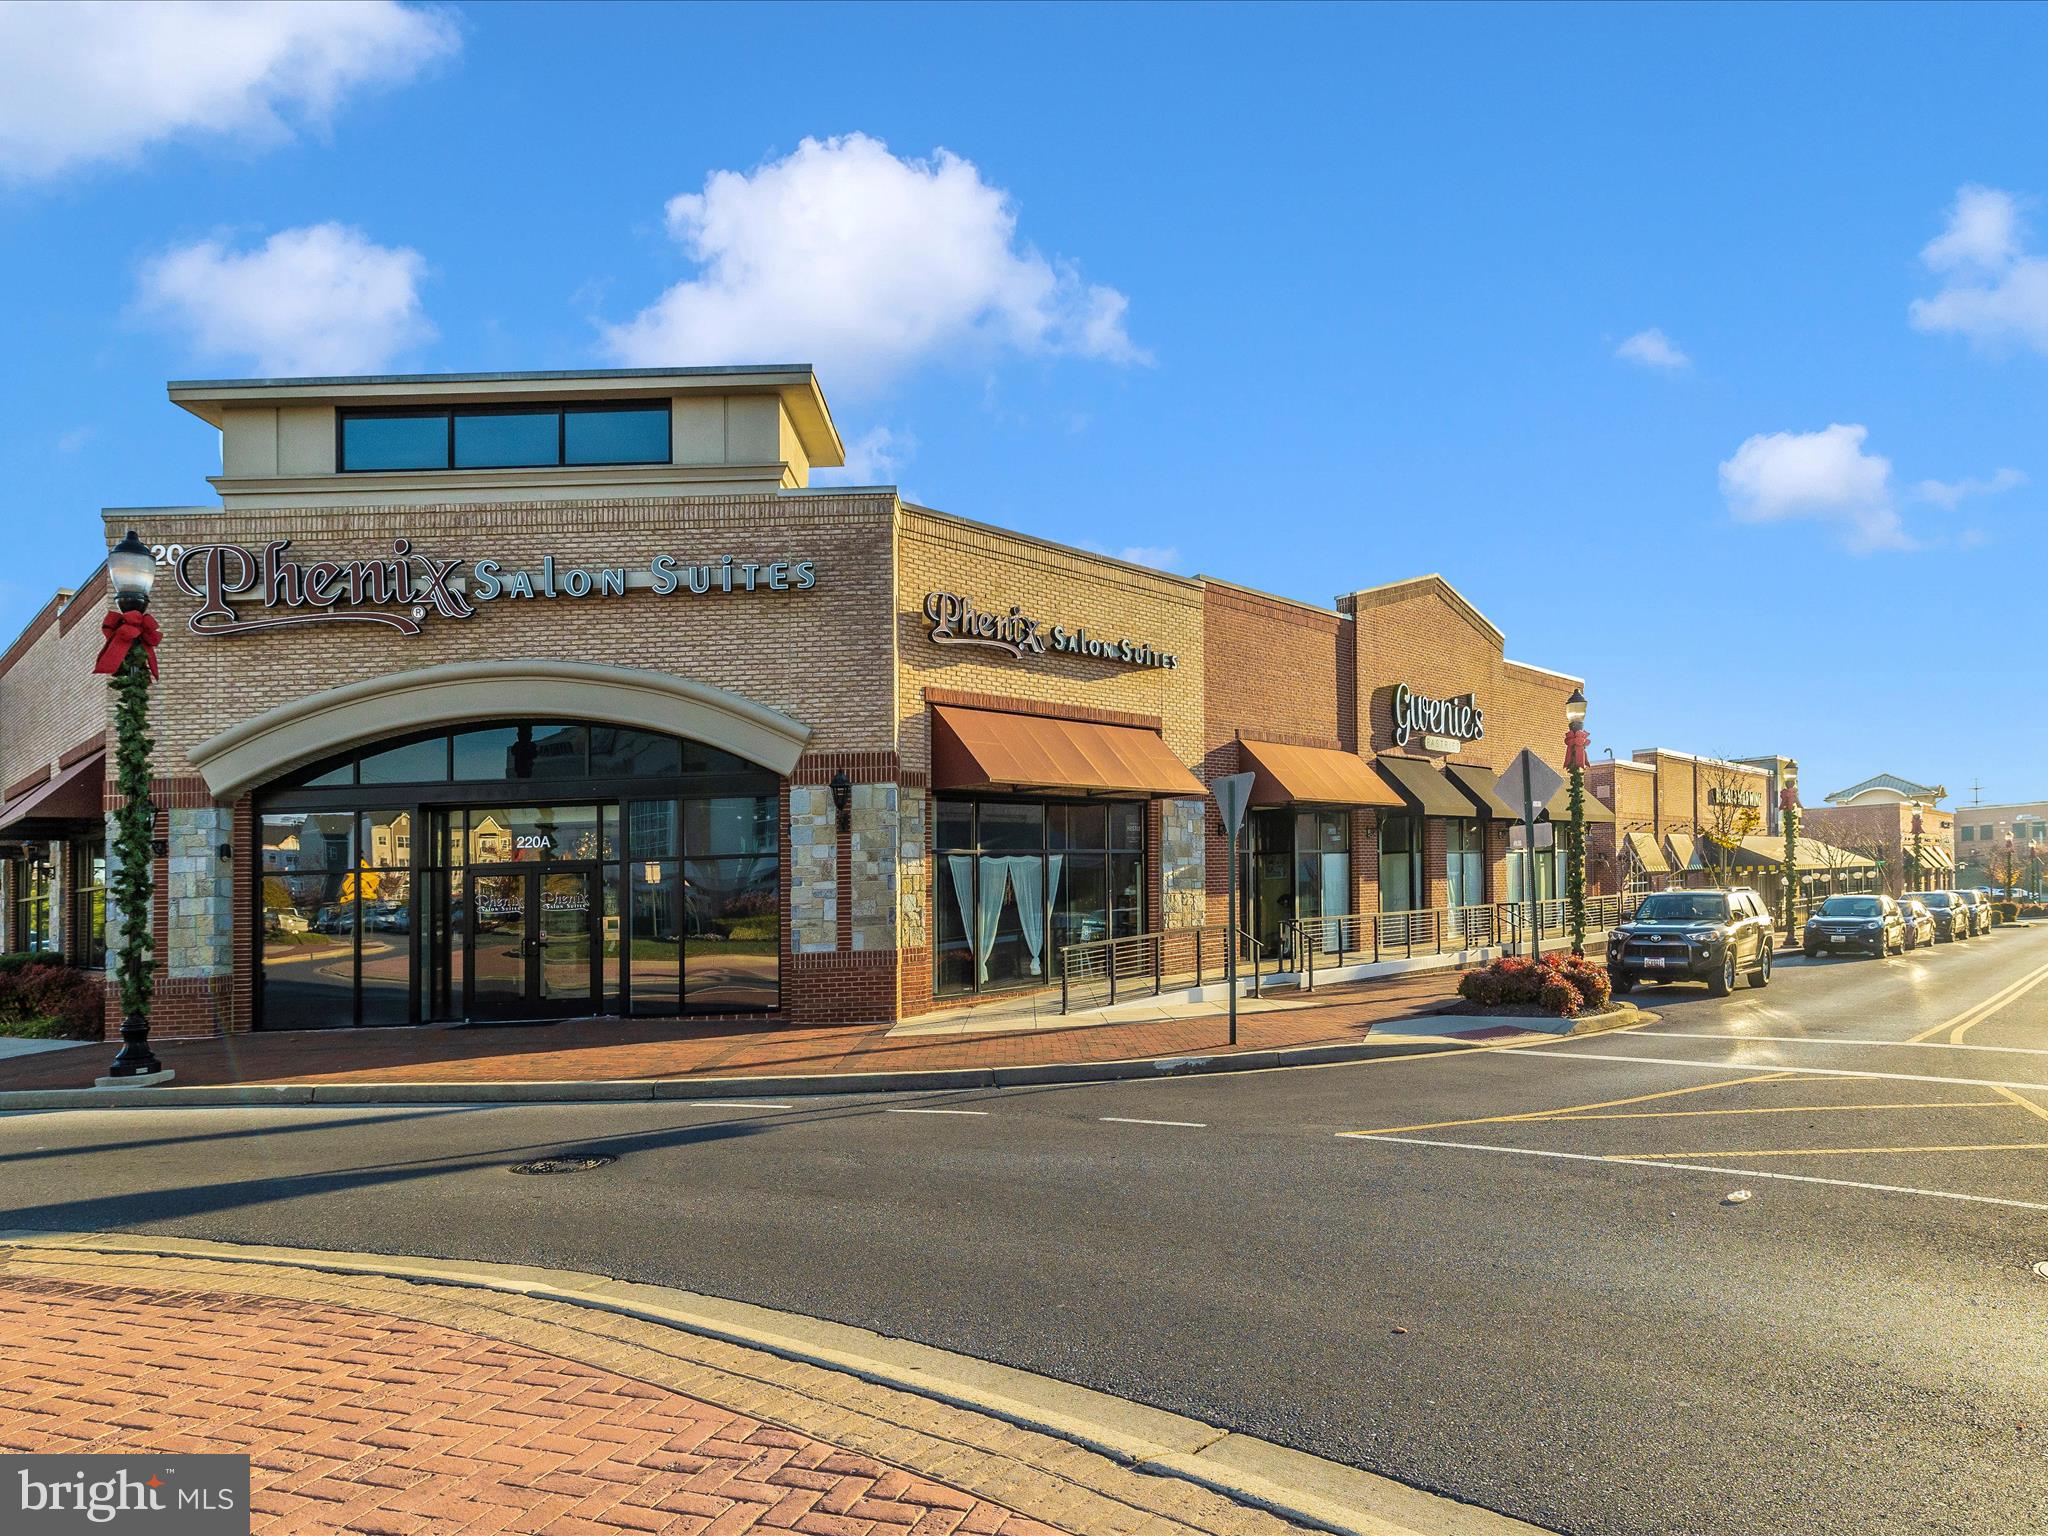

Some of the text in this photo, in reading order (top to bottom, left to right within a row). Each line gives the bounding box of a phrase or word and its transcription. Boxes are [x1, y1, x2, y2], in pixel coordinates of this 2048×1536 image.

[174, 538, 477, 635] Phenix
[923, 591, 1046, 660] Phenix
[1394, 682, 1485, 747] Gwenie's
[516, 835, 551, 849] 220A
[540, 892, 590, 912] Phenix
